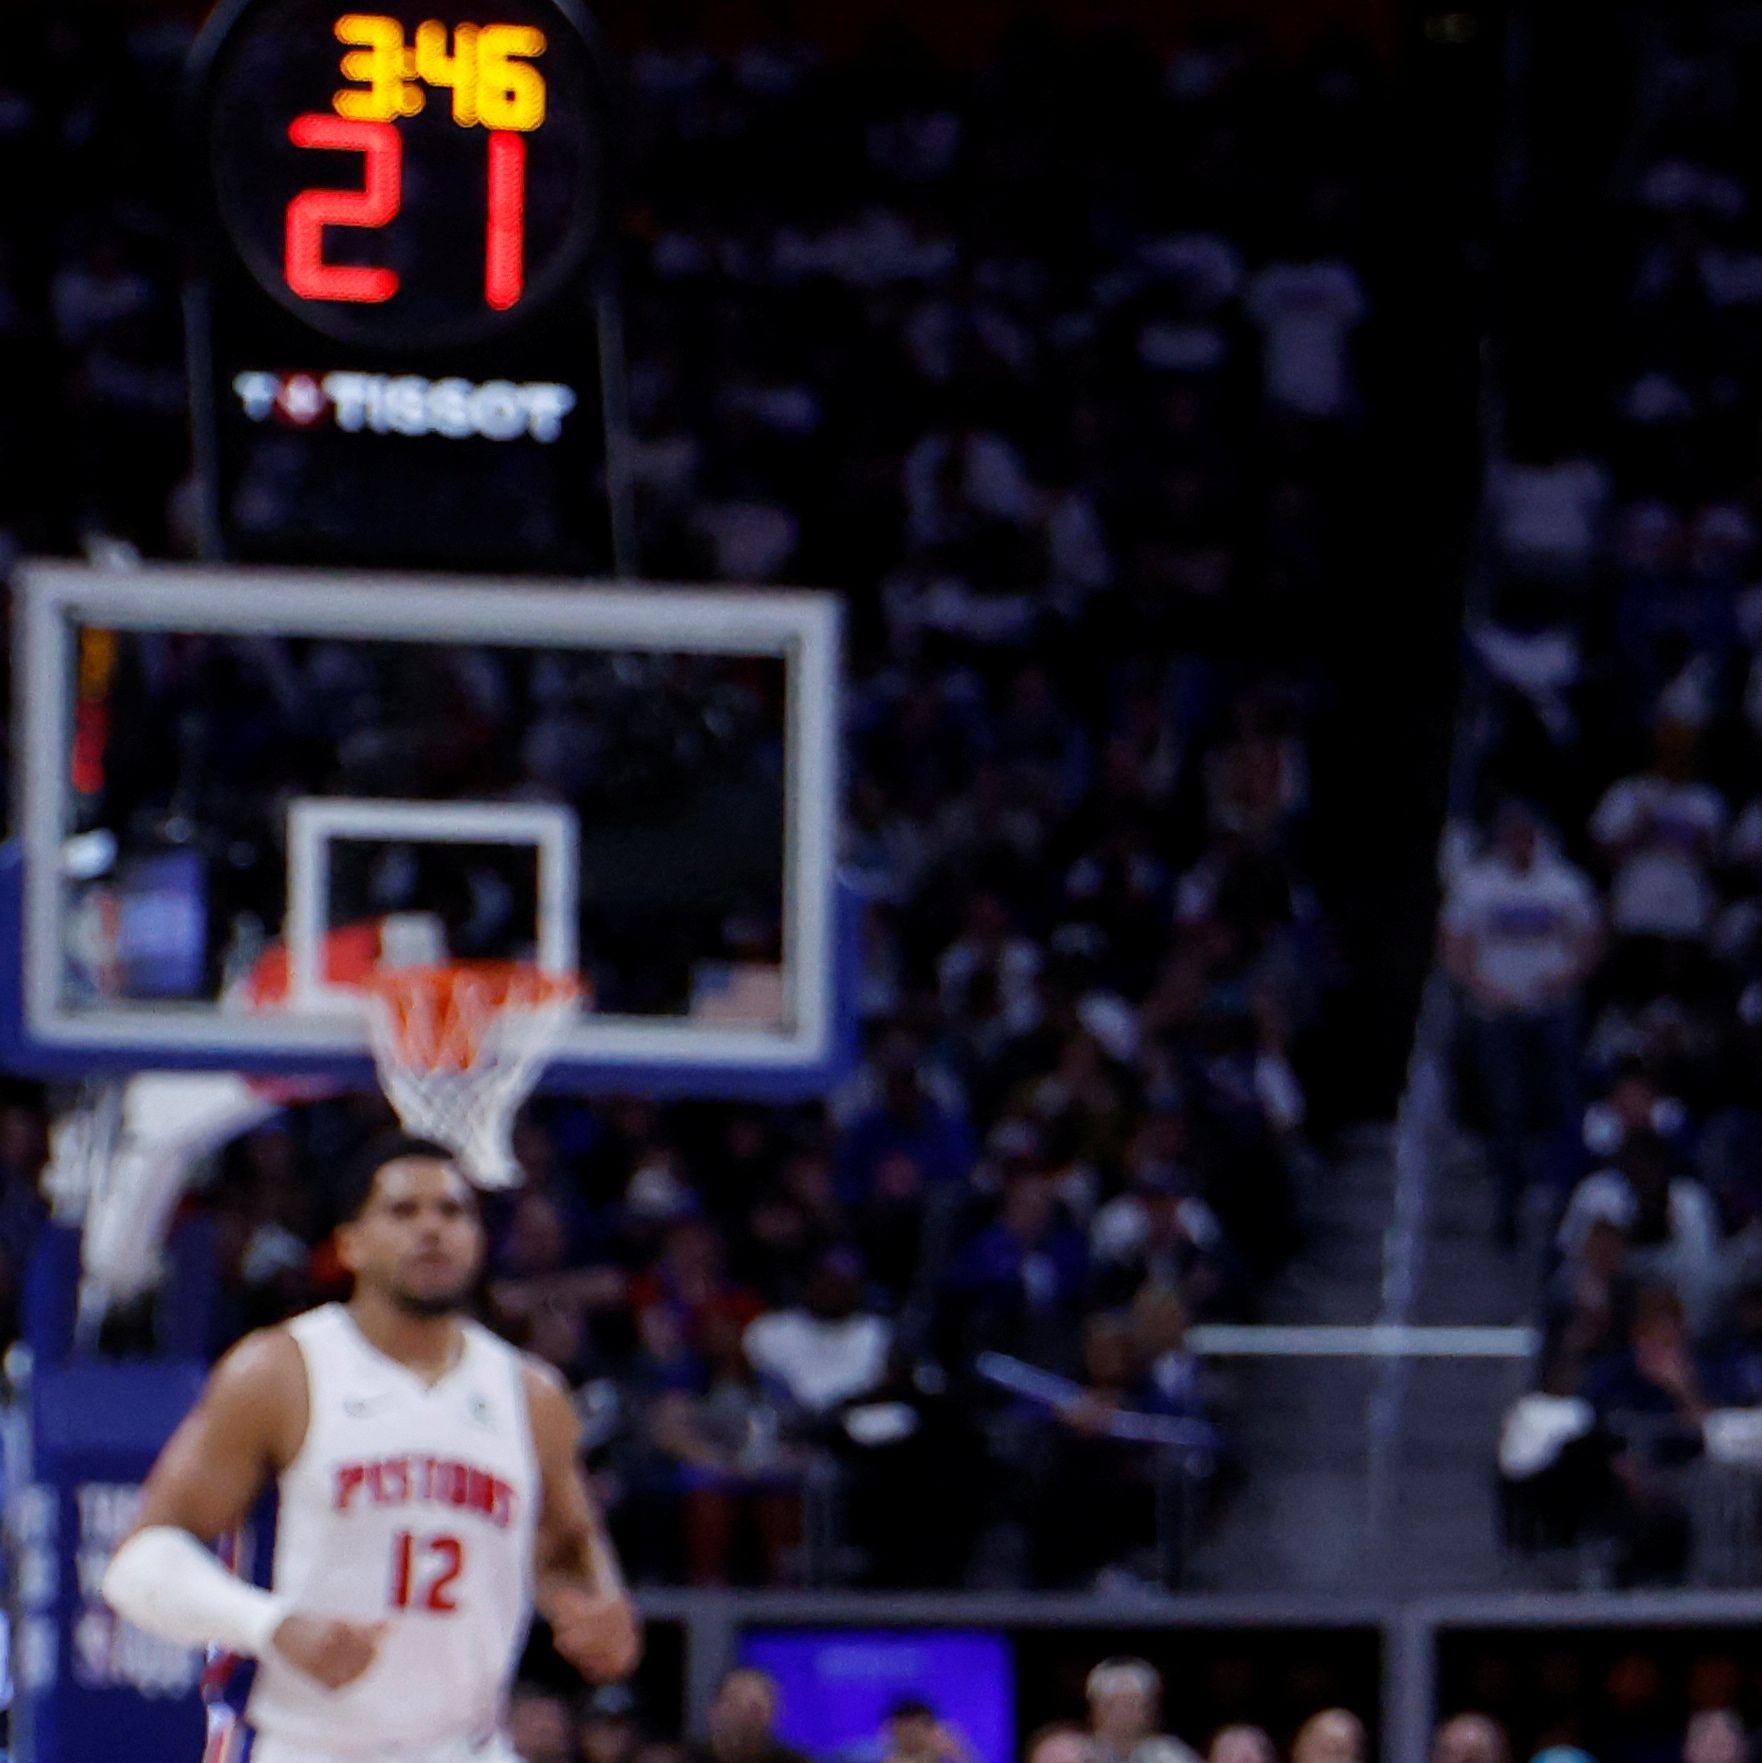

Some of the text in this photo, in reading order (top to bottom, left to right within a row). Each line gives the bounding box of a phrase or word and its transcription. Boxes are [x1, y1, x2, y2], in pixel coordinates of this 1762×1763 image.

[332, 14, 547, 131] 3:46
[285, 113, 526, 310] 21
[322, 371, 577, 443] TISSOT
[389, 1529, 465, 1614] 12
